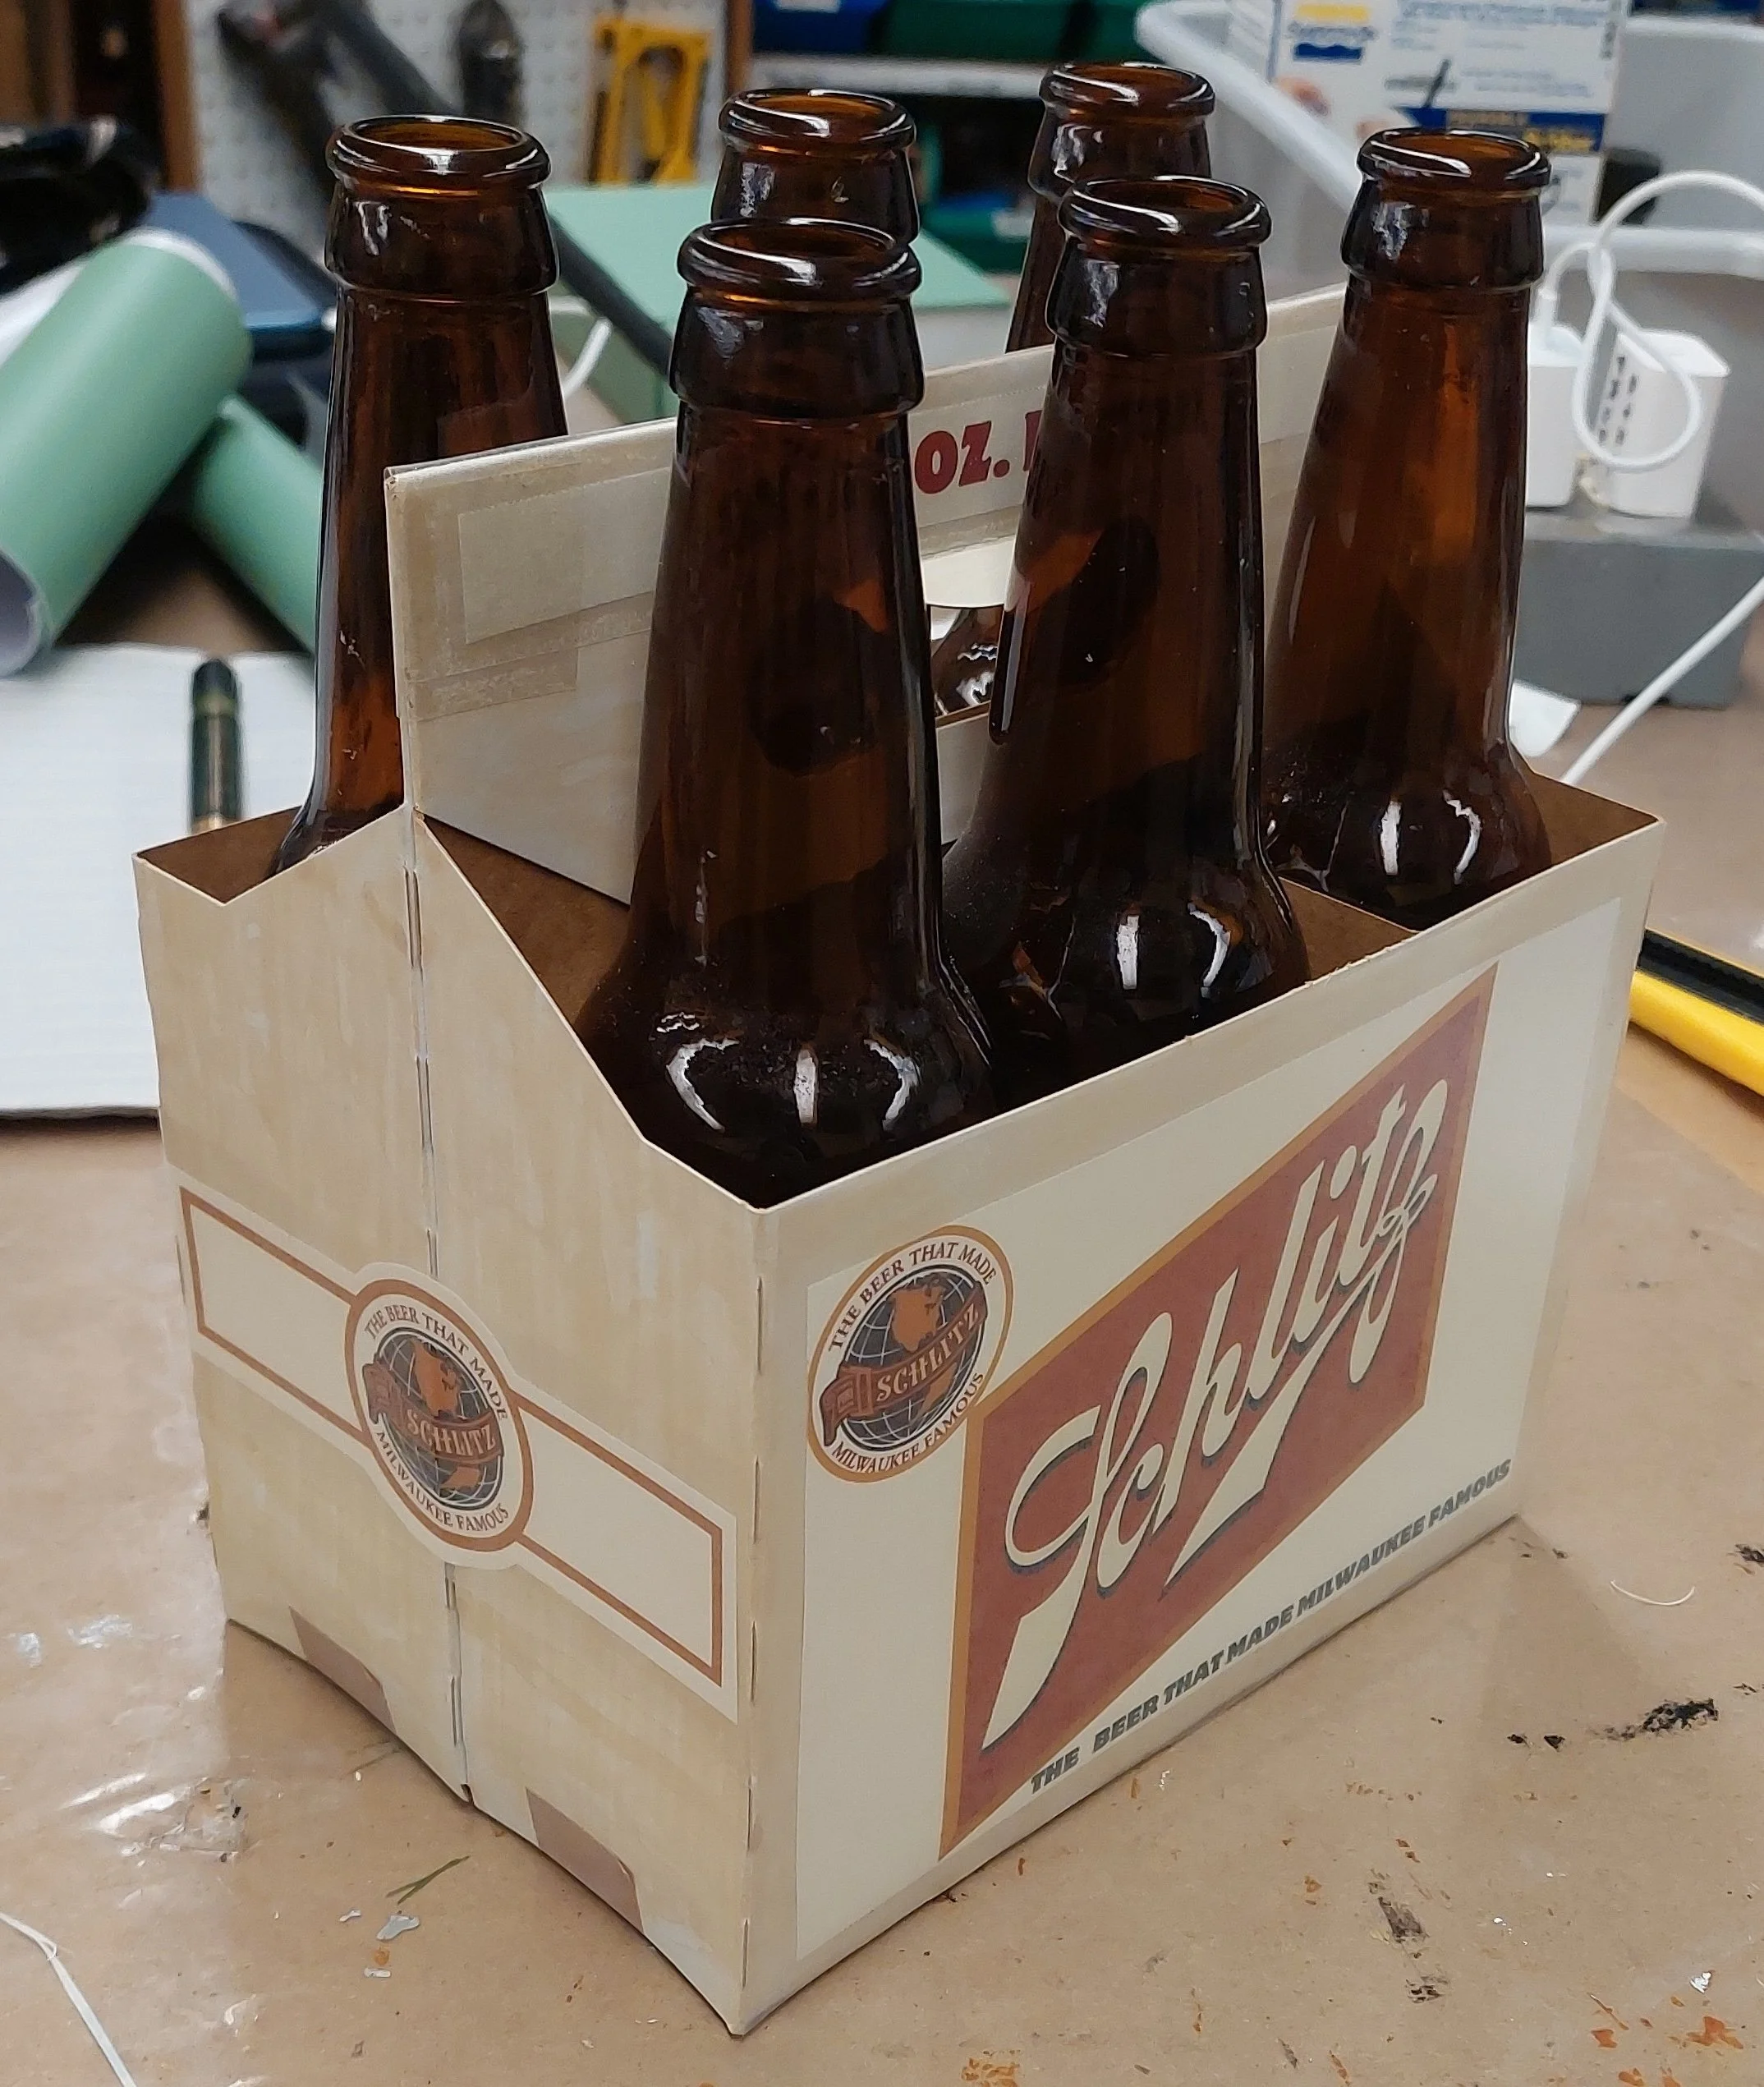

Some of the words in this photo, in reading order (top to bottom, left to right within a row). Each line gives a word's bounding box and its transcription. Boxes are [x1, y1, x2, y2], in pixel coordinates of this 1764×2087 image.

[914, 421, 1010, 494] OZ.
[828, 1306, 861, 1353] THE
[860, 1259, 905, 1304] BEER
[908, 1241, 959, 1266] THAT
[958, 1243, 997, 1285] MADE
[364, 1308, 388, 1340] THE
[384, 1304, 419, 1324] BEER
[421, 1312, 469, 1356] THAT
[470, 1356, 508, 1421] MADE
[875, 1303, 980, 1403] SCHLITZ
[406, 1408, 496, 1457] SCHLITZ
[831, 1440, 921, 1473] MILWAUKEE
[922, 1372, 985, 1455] FAMOUS
[981, 1078, 1449, 1752] Schlitz
[376, 1431, 453, 1528] MILWAUKEE
[455, 1501, 509, 1533] FAMOUS
[1031, 1745, 1080, 1795] THE
[1091, 1694, 1160, 1754] BEER
[1163, 1648, 1224, 1706] THAT
[1224, 1604, 1294, 1665] MADE
[1296, 1515, 1426, 1618] MILWAUKEE
[1428, 1458, 1512, 1528] FAMOUS
